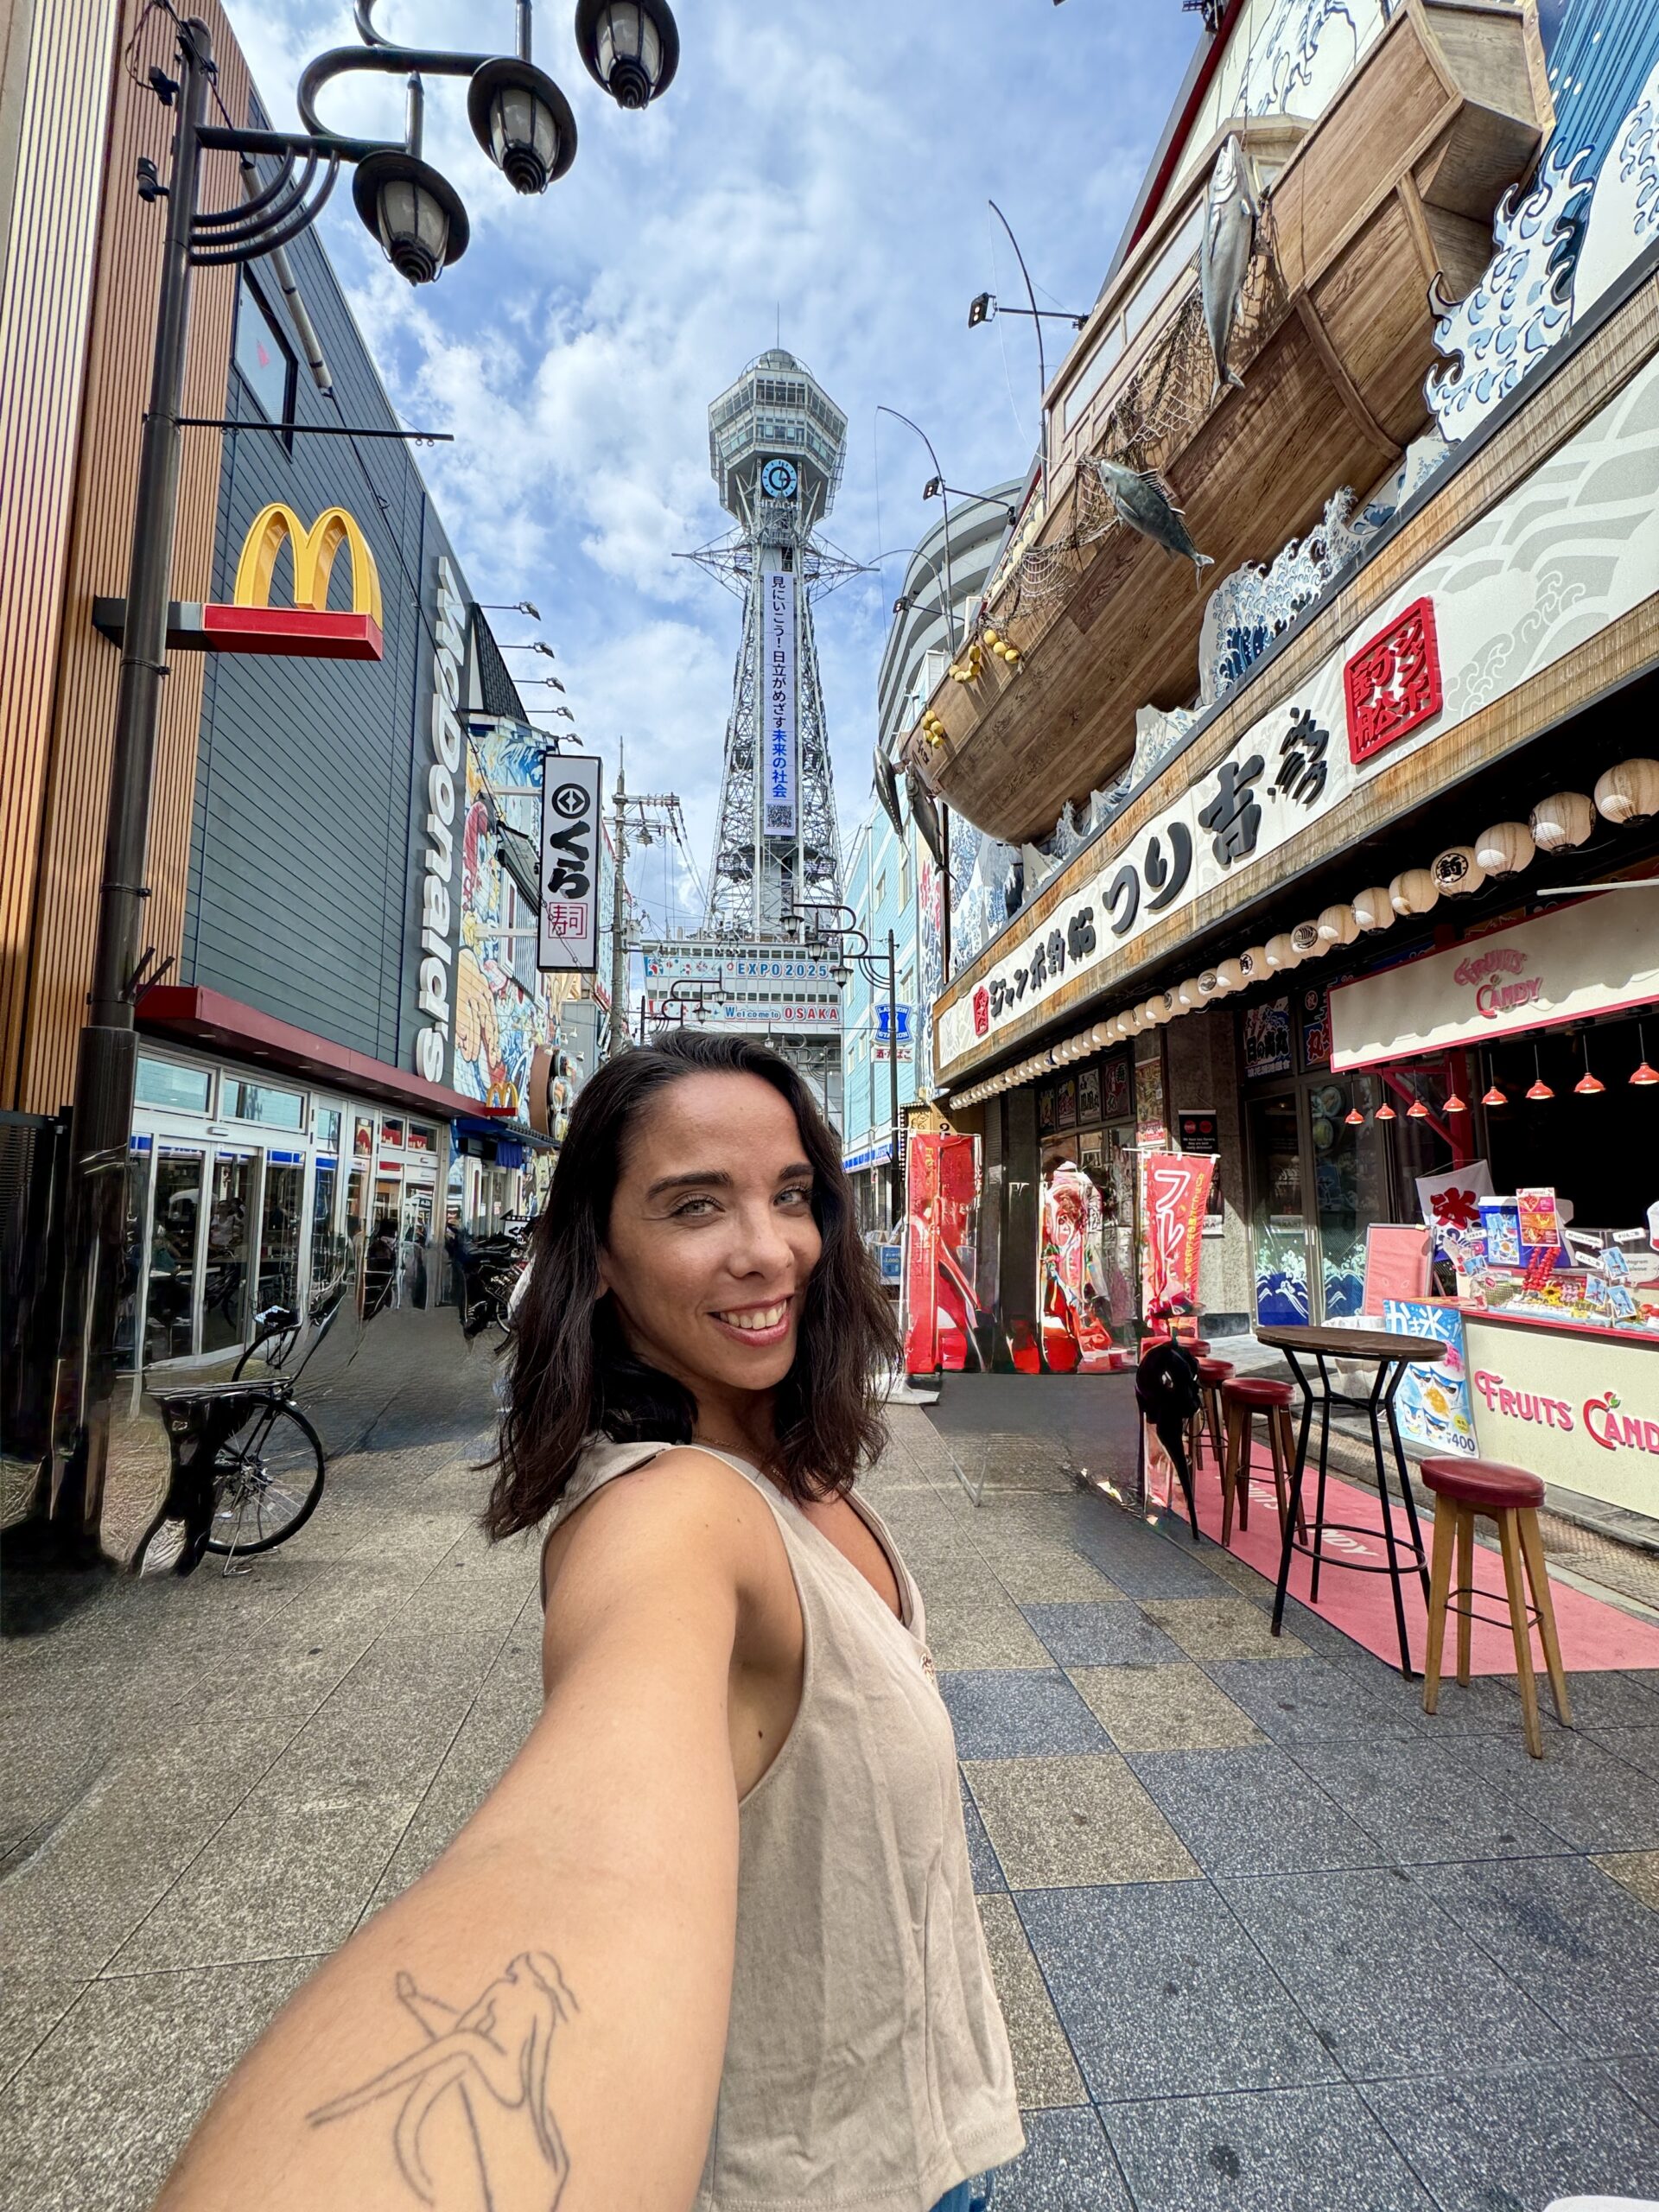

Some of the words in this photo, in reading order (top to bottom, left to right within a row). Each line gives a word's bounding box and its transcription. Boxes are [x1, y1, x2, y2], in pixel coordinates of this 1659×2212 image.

[416, 556, 467, 1083] McDonald's
[1102, 753, 1265, 936] つり吉
[547, 820, 591, 899] くら
[725, 1007, 769, 1019] Welcome
[771, 1010, 780, 1019] to
[784, 1007, 837, 1020] OSAKA
[1474, 1370, 1574, 1431] FRUITS
